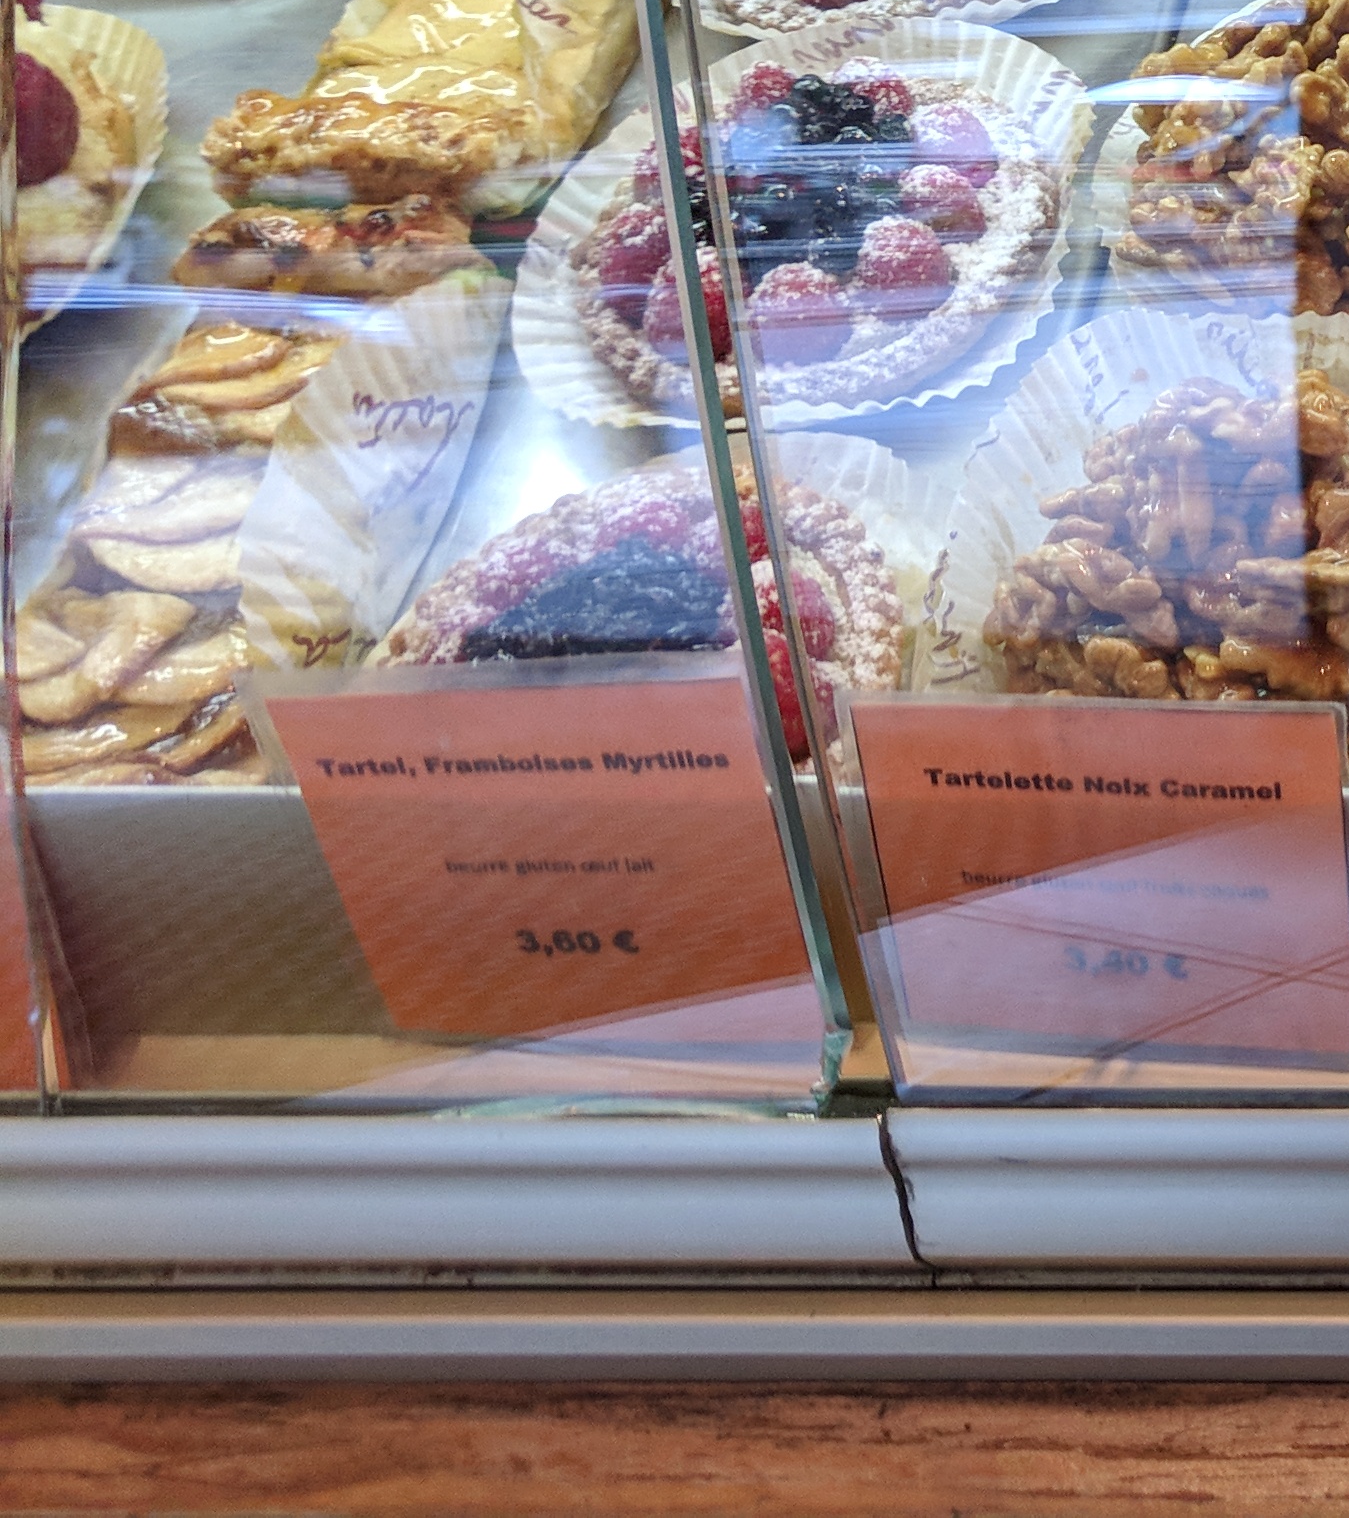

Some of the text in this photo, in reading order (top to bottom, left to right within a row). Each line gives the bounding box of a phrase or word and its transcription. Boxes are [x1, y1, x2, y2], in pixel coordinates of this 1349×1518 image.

[423, 753, 593, 775] Framboises
[602, 749, 730, 776] Myrtilles
[924, 767, 1282, 800] Tartelette Noix Caramel
[515, 929, 640, 958] 3,60 €
